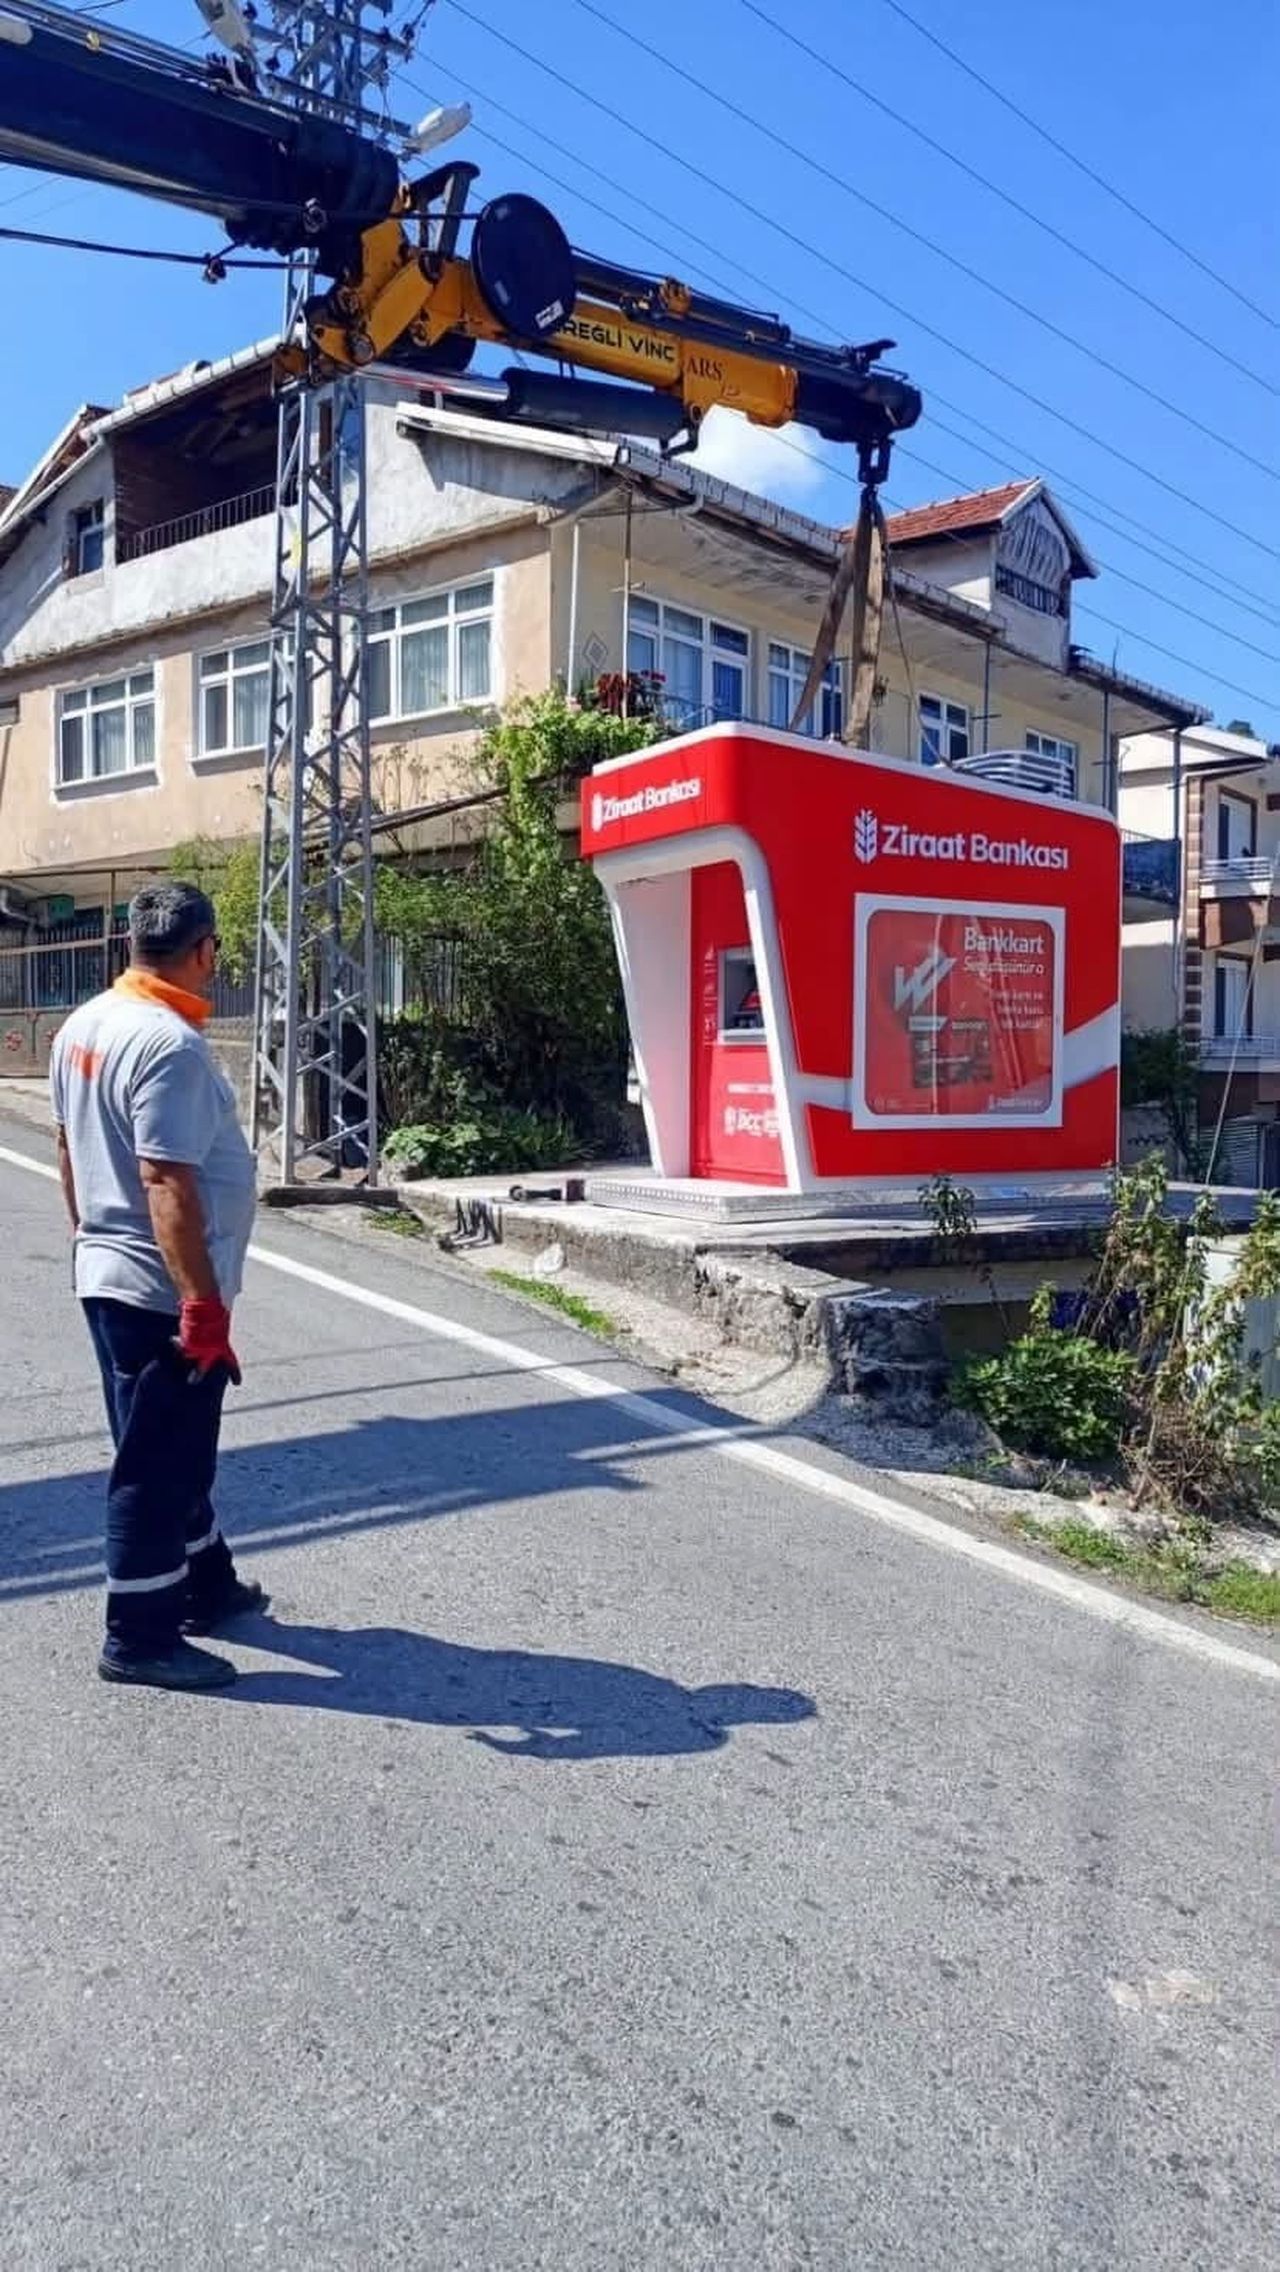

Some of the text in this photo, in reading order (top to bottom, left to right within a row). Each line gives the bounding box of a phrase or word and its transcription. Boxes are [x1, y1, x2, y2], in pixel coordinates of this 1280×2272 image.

[602, 777, 701, 823] Ziraat Bankası
[881, 824, 1068, 870] Ziraat Bankası
[964, 926, 1045, 955] Bankkart
